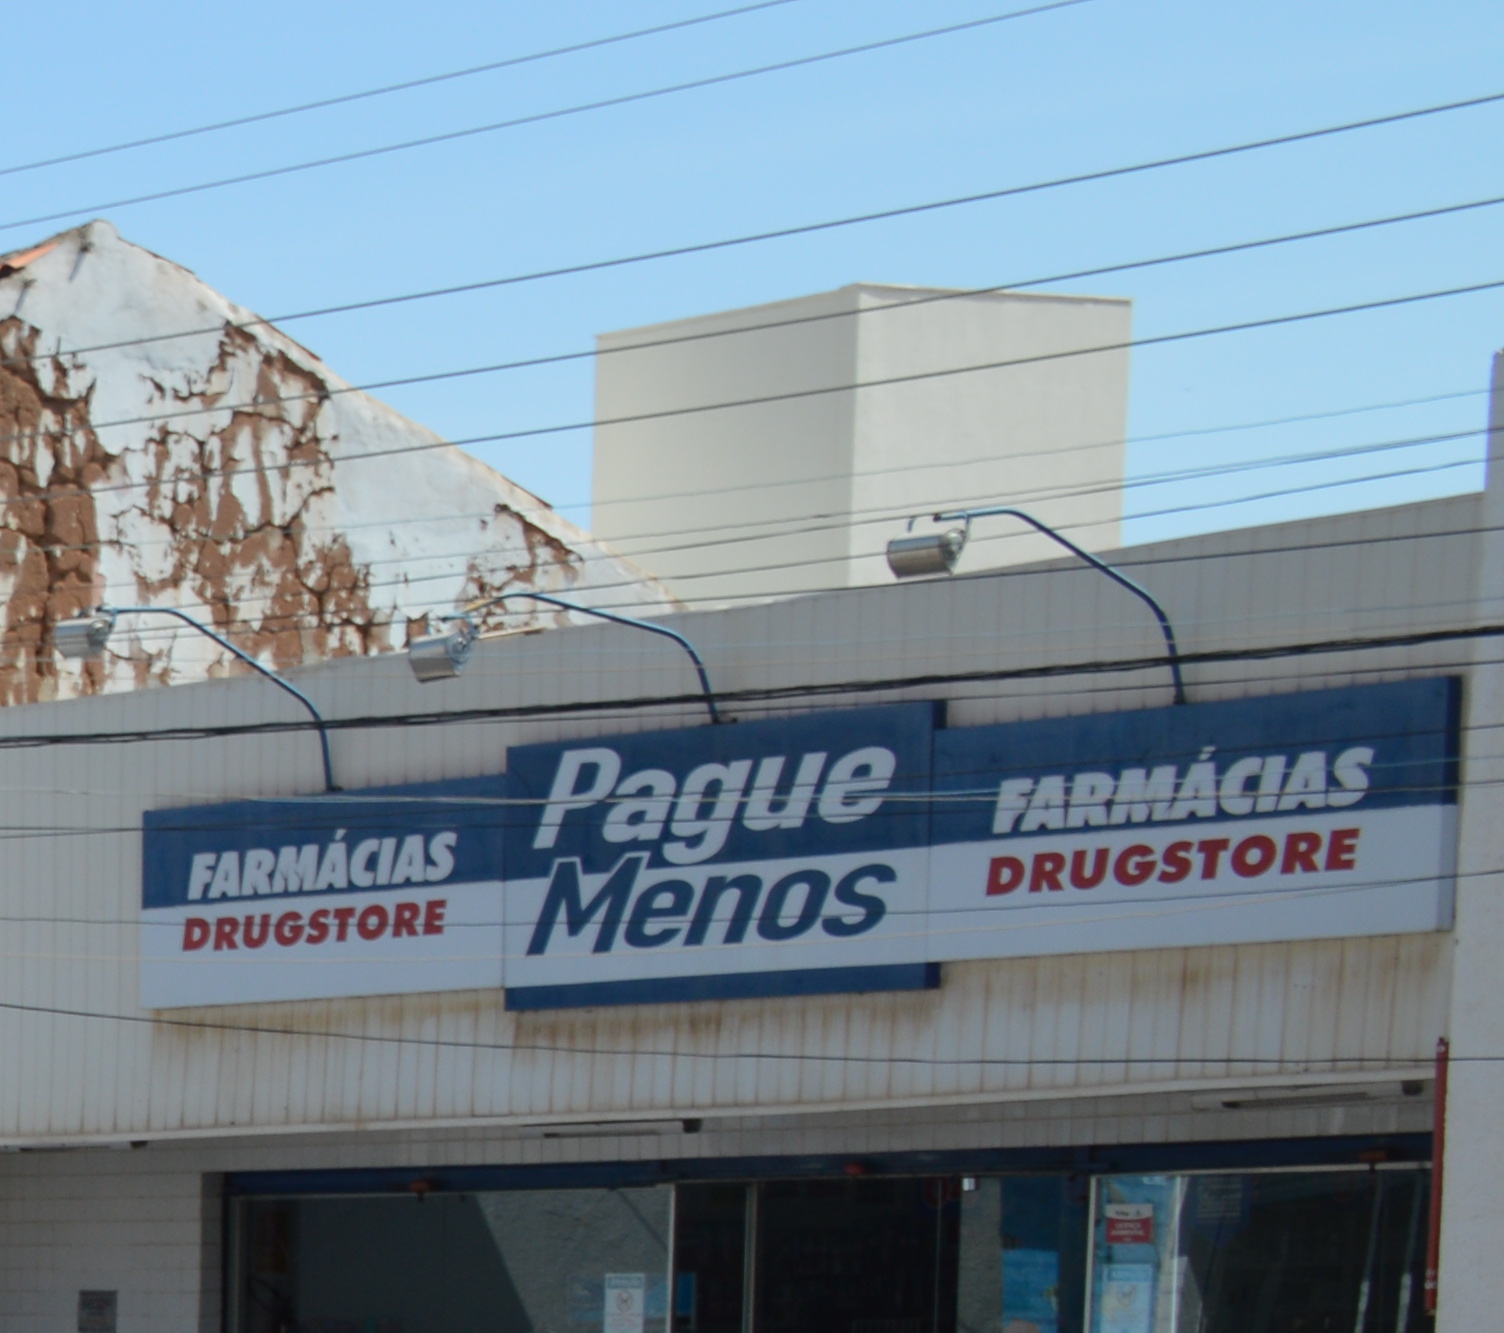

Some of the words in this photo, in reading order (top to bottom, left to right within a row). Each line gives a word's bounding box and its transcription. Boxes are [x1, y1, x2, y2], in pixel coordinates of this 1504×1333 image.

[533, 746, 897, 866] Pague
[991, 745, 1375, 836] FARMÁCIAS
[187, 828, 457, 901] FARMÁCIAS
[984, 826, 1361, 898] DRUGSTORE
[180, 898, 448, 953] DRUGSTORE
[525, 855, 898, 958] Menos
